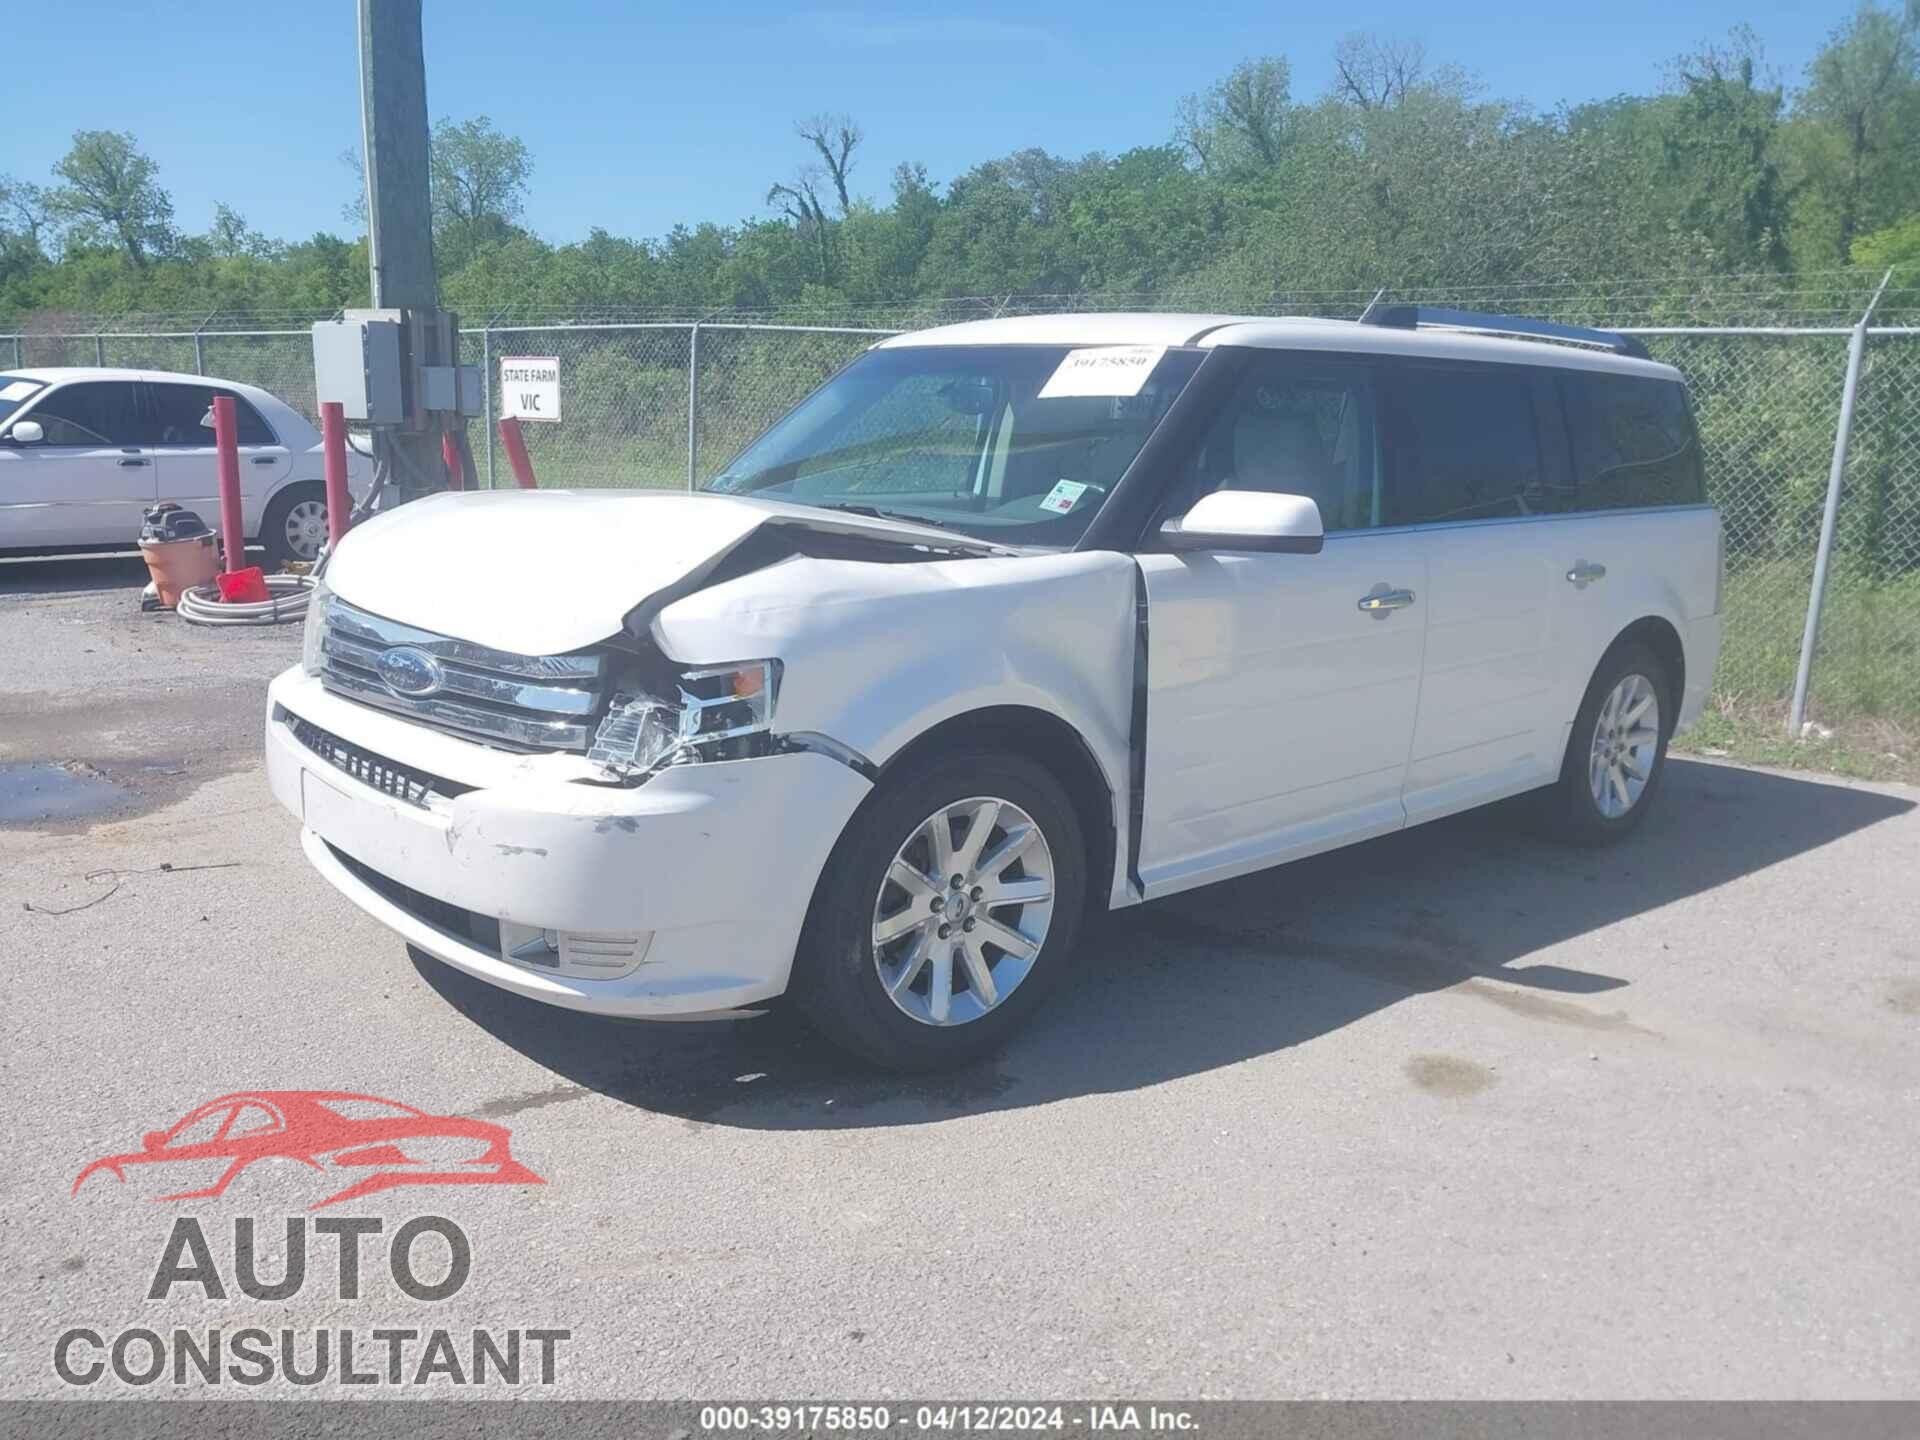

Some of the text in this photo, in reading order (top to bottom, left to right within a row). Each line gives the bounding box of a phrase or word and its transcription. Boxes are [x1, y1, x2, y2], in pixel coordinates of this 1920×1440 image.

[503, 368, 556, 382] STATE FARM
[520, 393, 541, 411] VIC
